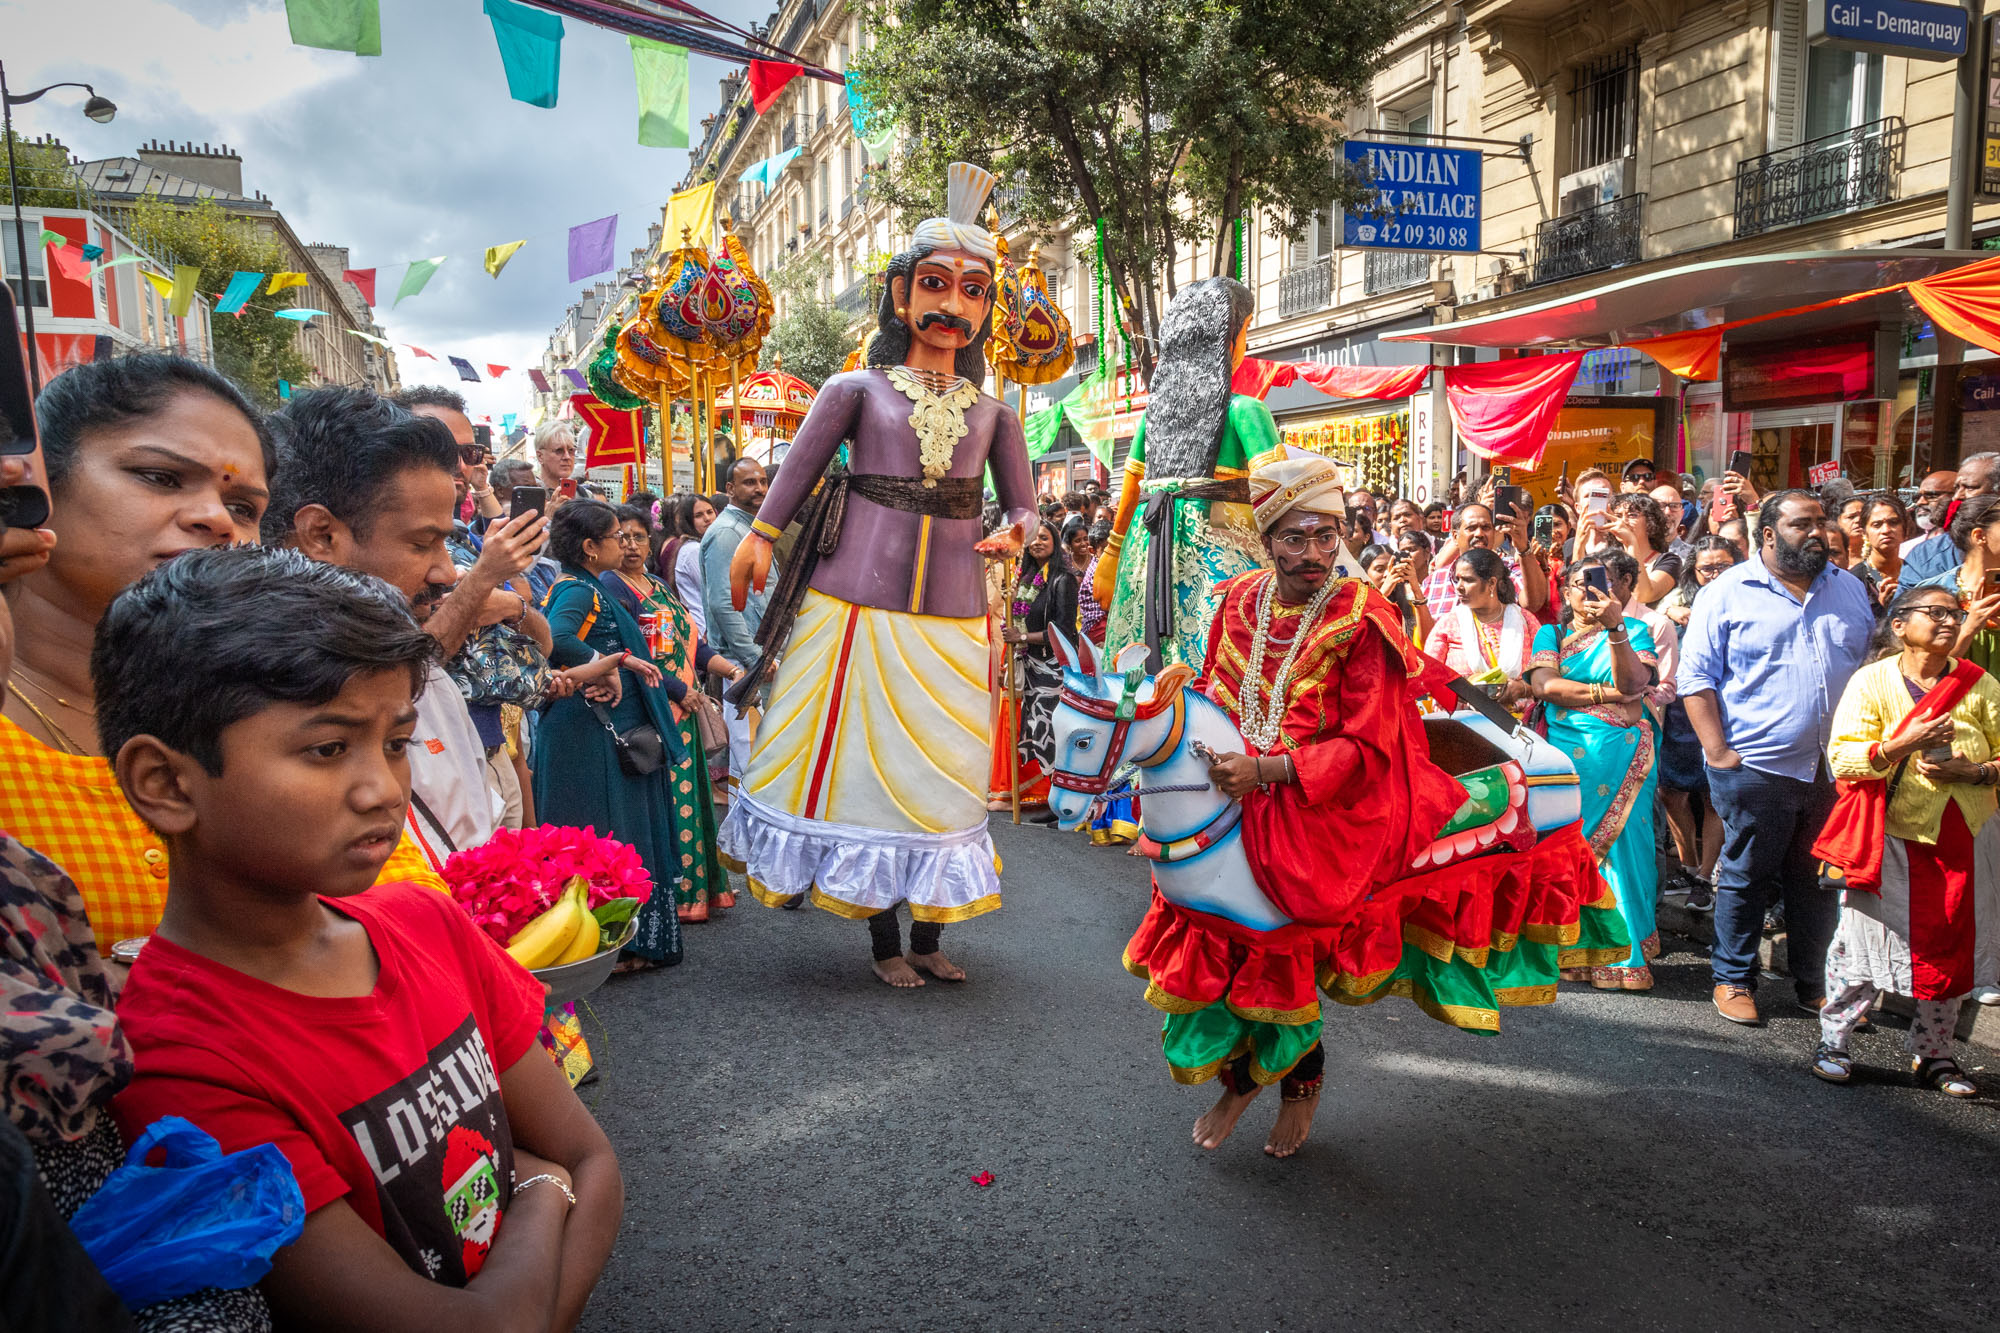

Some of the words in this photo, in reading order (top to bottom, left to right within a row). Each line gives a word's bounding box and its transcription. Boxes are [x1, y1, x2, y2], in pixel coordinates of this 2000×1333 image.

[1831, 4, 1860, 27] Cail
[1876, 10, 1962, 46] Demarquay
[1366, 147, 1460, 186] INDIAN
[1401, 190, 1476, 219] PALACE
[1380, 223, 1401, 243] 42
[1404, 224, 1424, 245] 09
[1427, 226, 1446, 246] 30
[1448, 227, 1468, 247] 88
[1973, 386, 1995, 400] Cail
